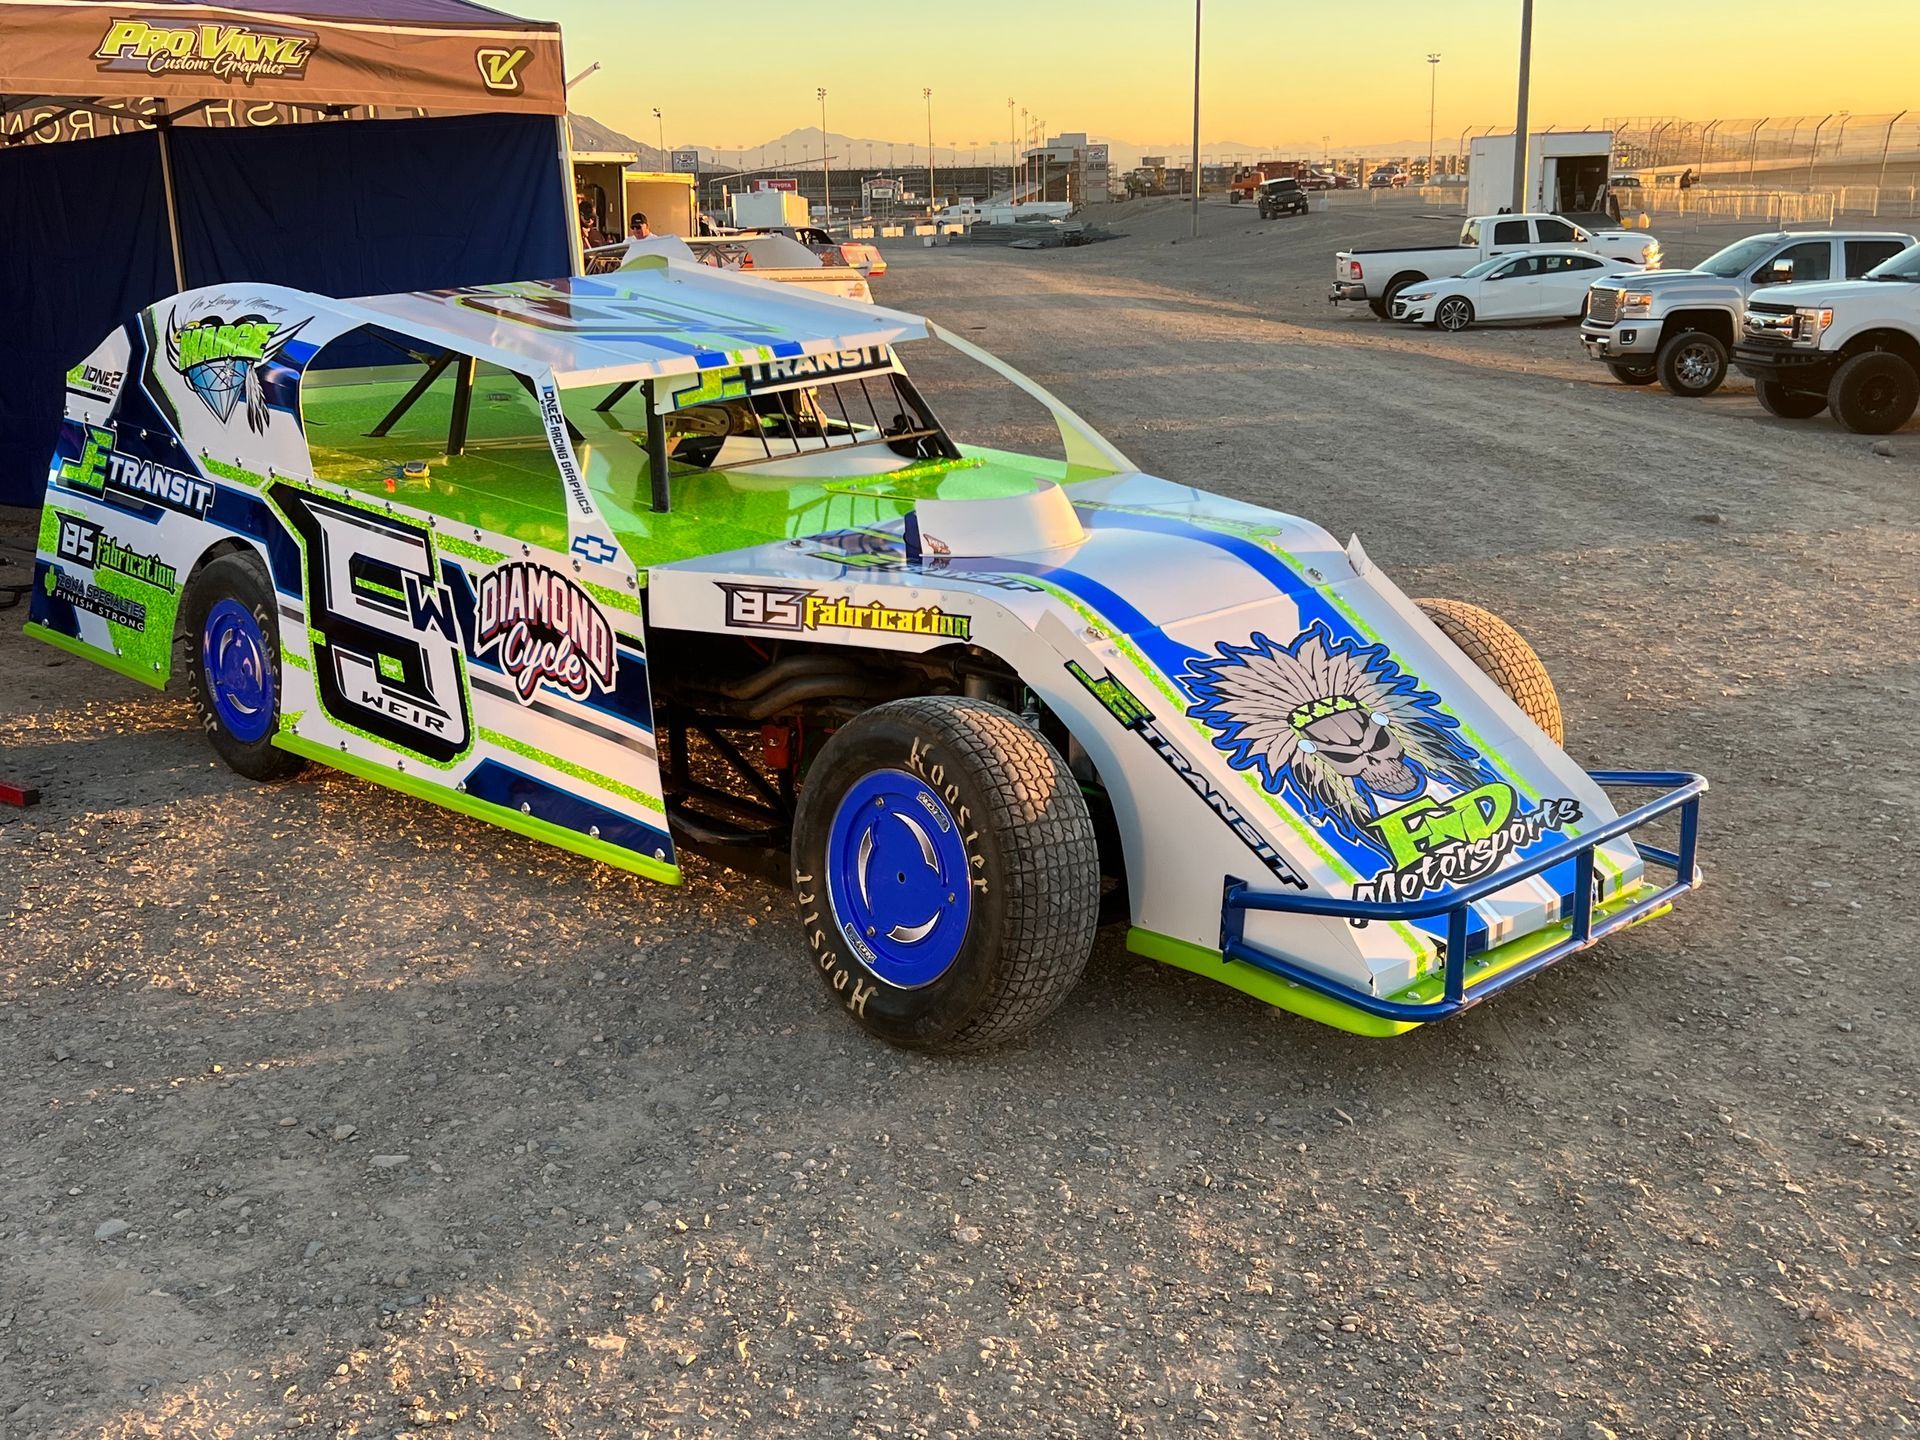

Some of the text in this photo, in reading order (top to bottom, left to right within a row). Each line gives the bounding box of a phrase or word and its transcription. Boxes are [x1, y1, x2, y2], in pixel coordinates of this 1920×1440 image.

[147, 51, 285, 83] Custom Graphics
[179, 321, 282, 371] MARGE
[749, 343, 890, 382] TRANSIT
[109, 455, 211, 512] TRANSIT
[550, 426, 569, 460] RACING
[561, 461, 593, 515] GRAPHICS
[56, 590, 144, 631] FINISH STRONG
[480, 565, 612, 681] DIAMOND
[504, 621, 585, 691] Cycle
[361, 690, 445, 734] WEIR
[904, 736, 989, 894] Hoosier
[1138, 718, 1308, 890] TRANSIT
[1350, 799, 1582, 927] Motorsports
[795, 869, 879, 1019] Hoosier
